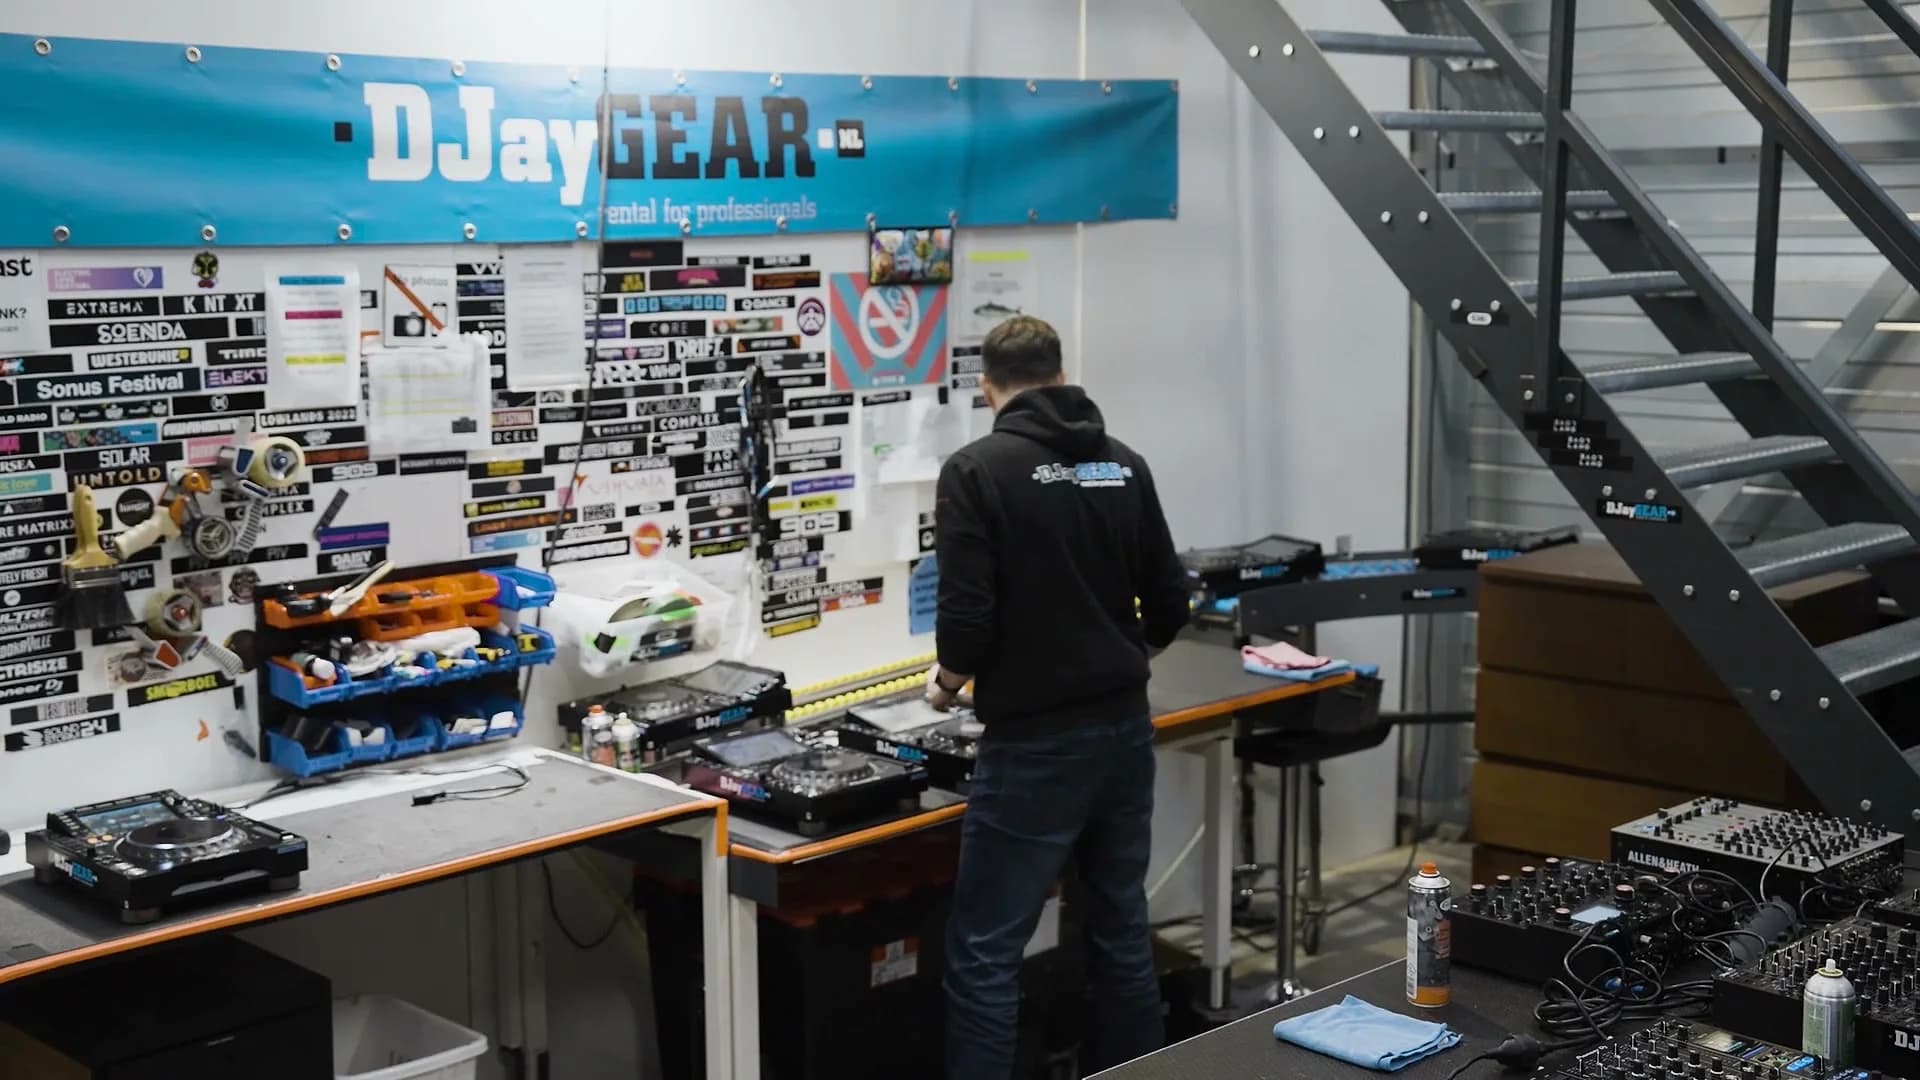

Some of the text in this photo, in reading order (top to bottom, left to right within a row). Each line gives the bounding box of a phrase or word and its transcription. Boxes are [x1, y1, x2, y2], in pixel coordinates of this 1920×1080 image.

[363, 82, 816, 206] DJayGEAR
[598, 194, 817, 227] ental for professionals
[66, 301, 143, 315] EXTREMA
[97, 321, 187, 344] SOENDA
[37, 372, 184, 399] Sonus Festival
[261, 411, 324, 427] LOWLANDS
[659, 413, 720, 431] COMPLEX
[99, 446, 151, 468] SOLAR
[74, 467, 162, 487] UNTOLD
[1627, 850, 1700, 873] ALLEN&HEATH
